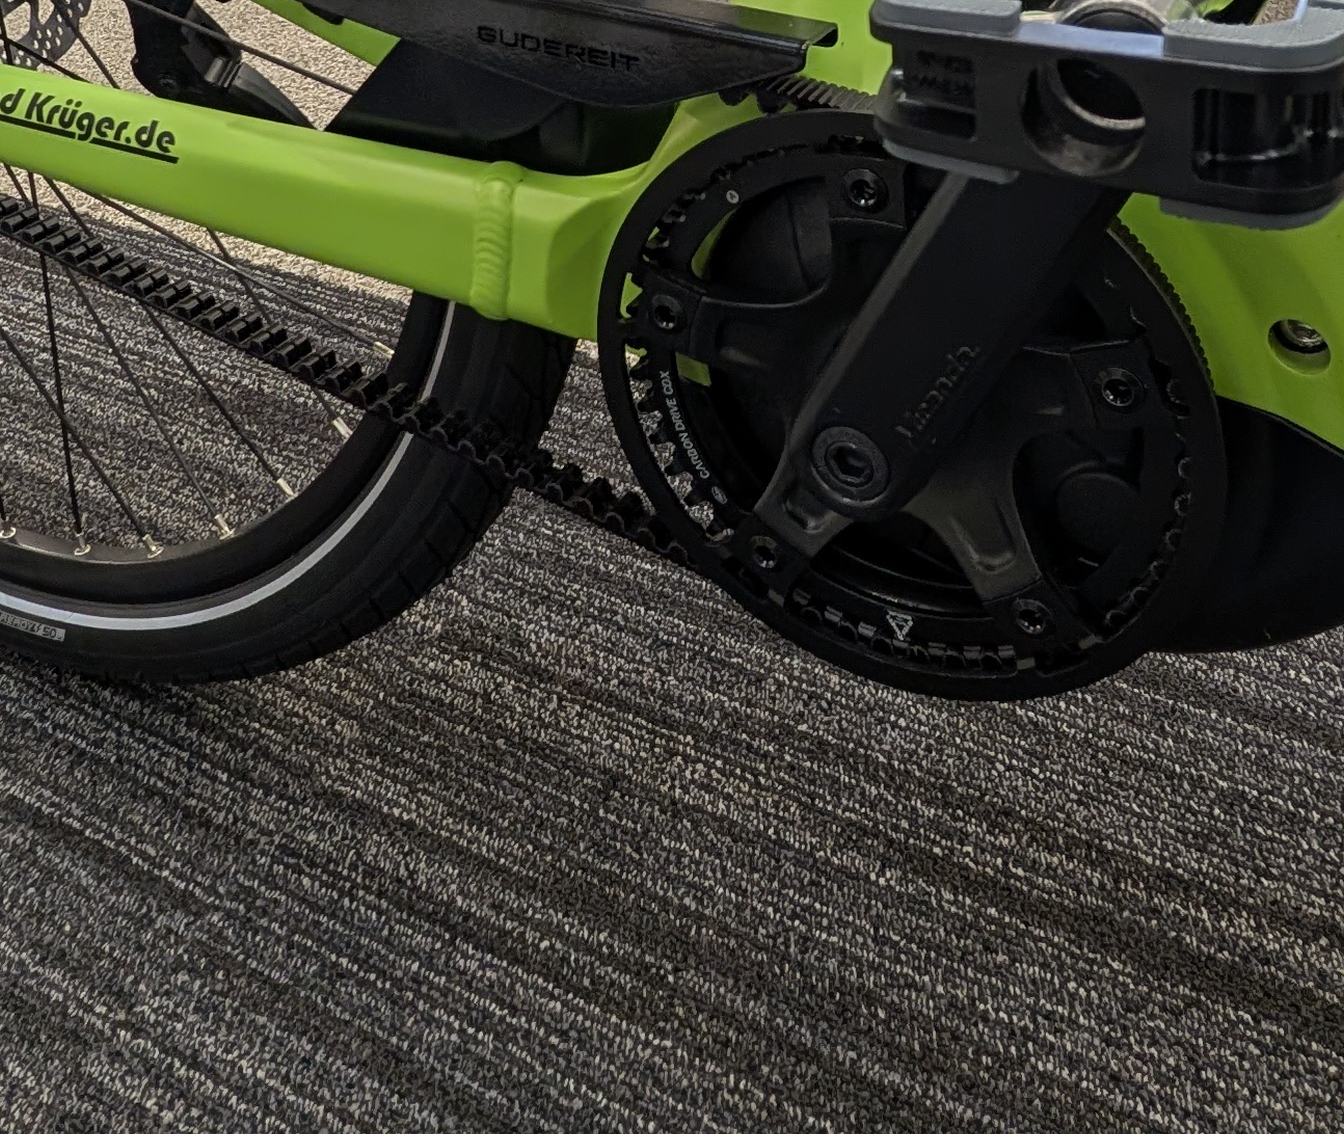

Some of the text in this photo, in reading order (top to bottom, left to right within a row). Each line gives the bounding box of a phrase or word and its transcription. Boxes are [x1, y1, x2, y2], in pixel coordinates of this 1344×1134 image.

[477, 26, 640, 71] GUDEREIT
[24, 92, 176, 154] Krüger.de
[666, 397, 686, 431] DRIVE
[679, 432, 710, 479] CARBON
